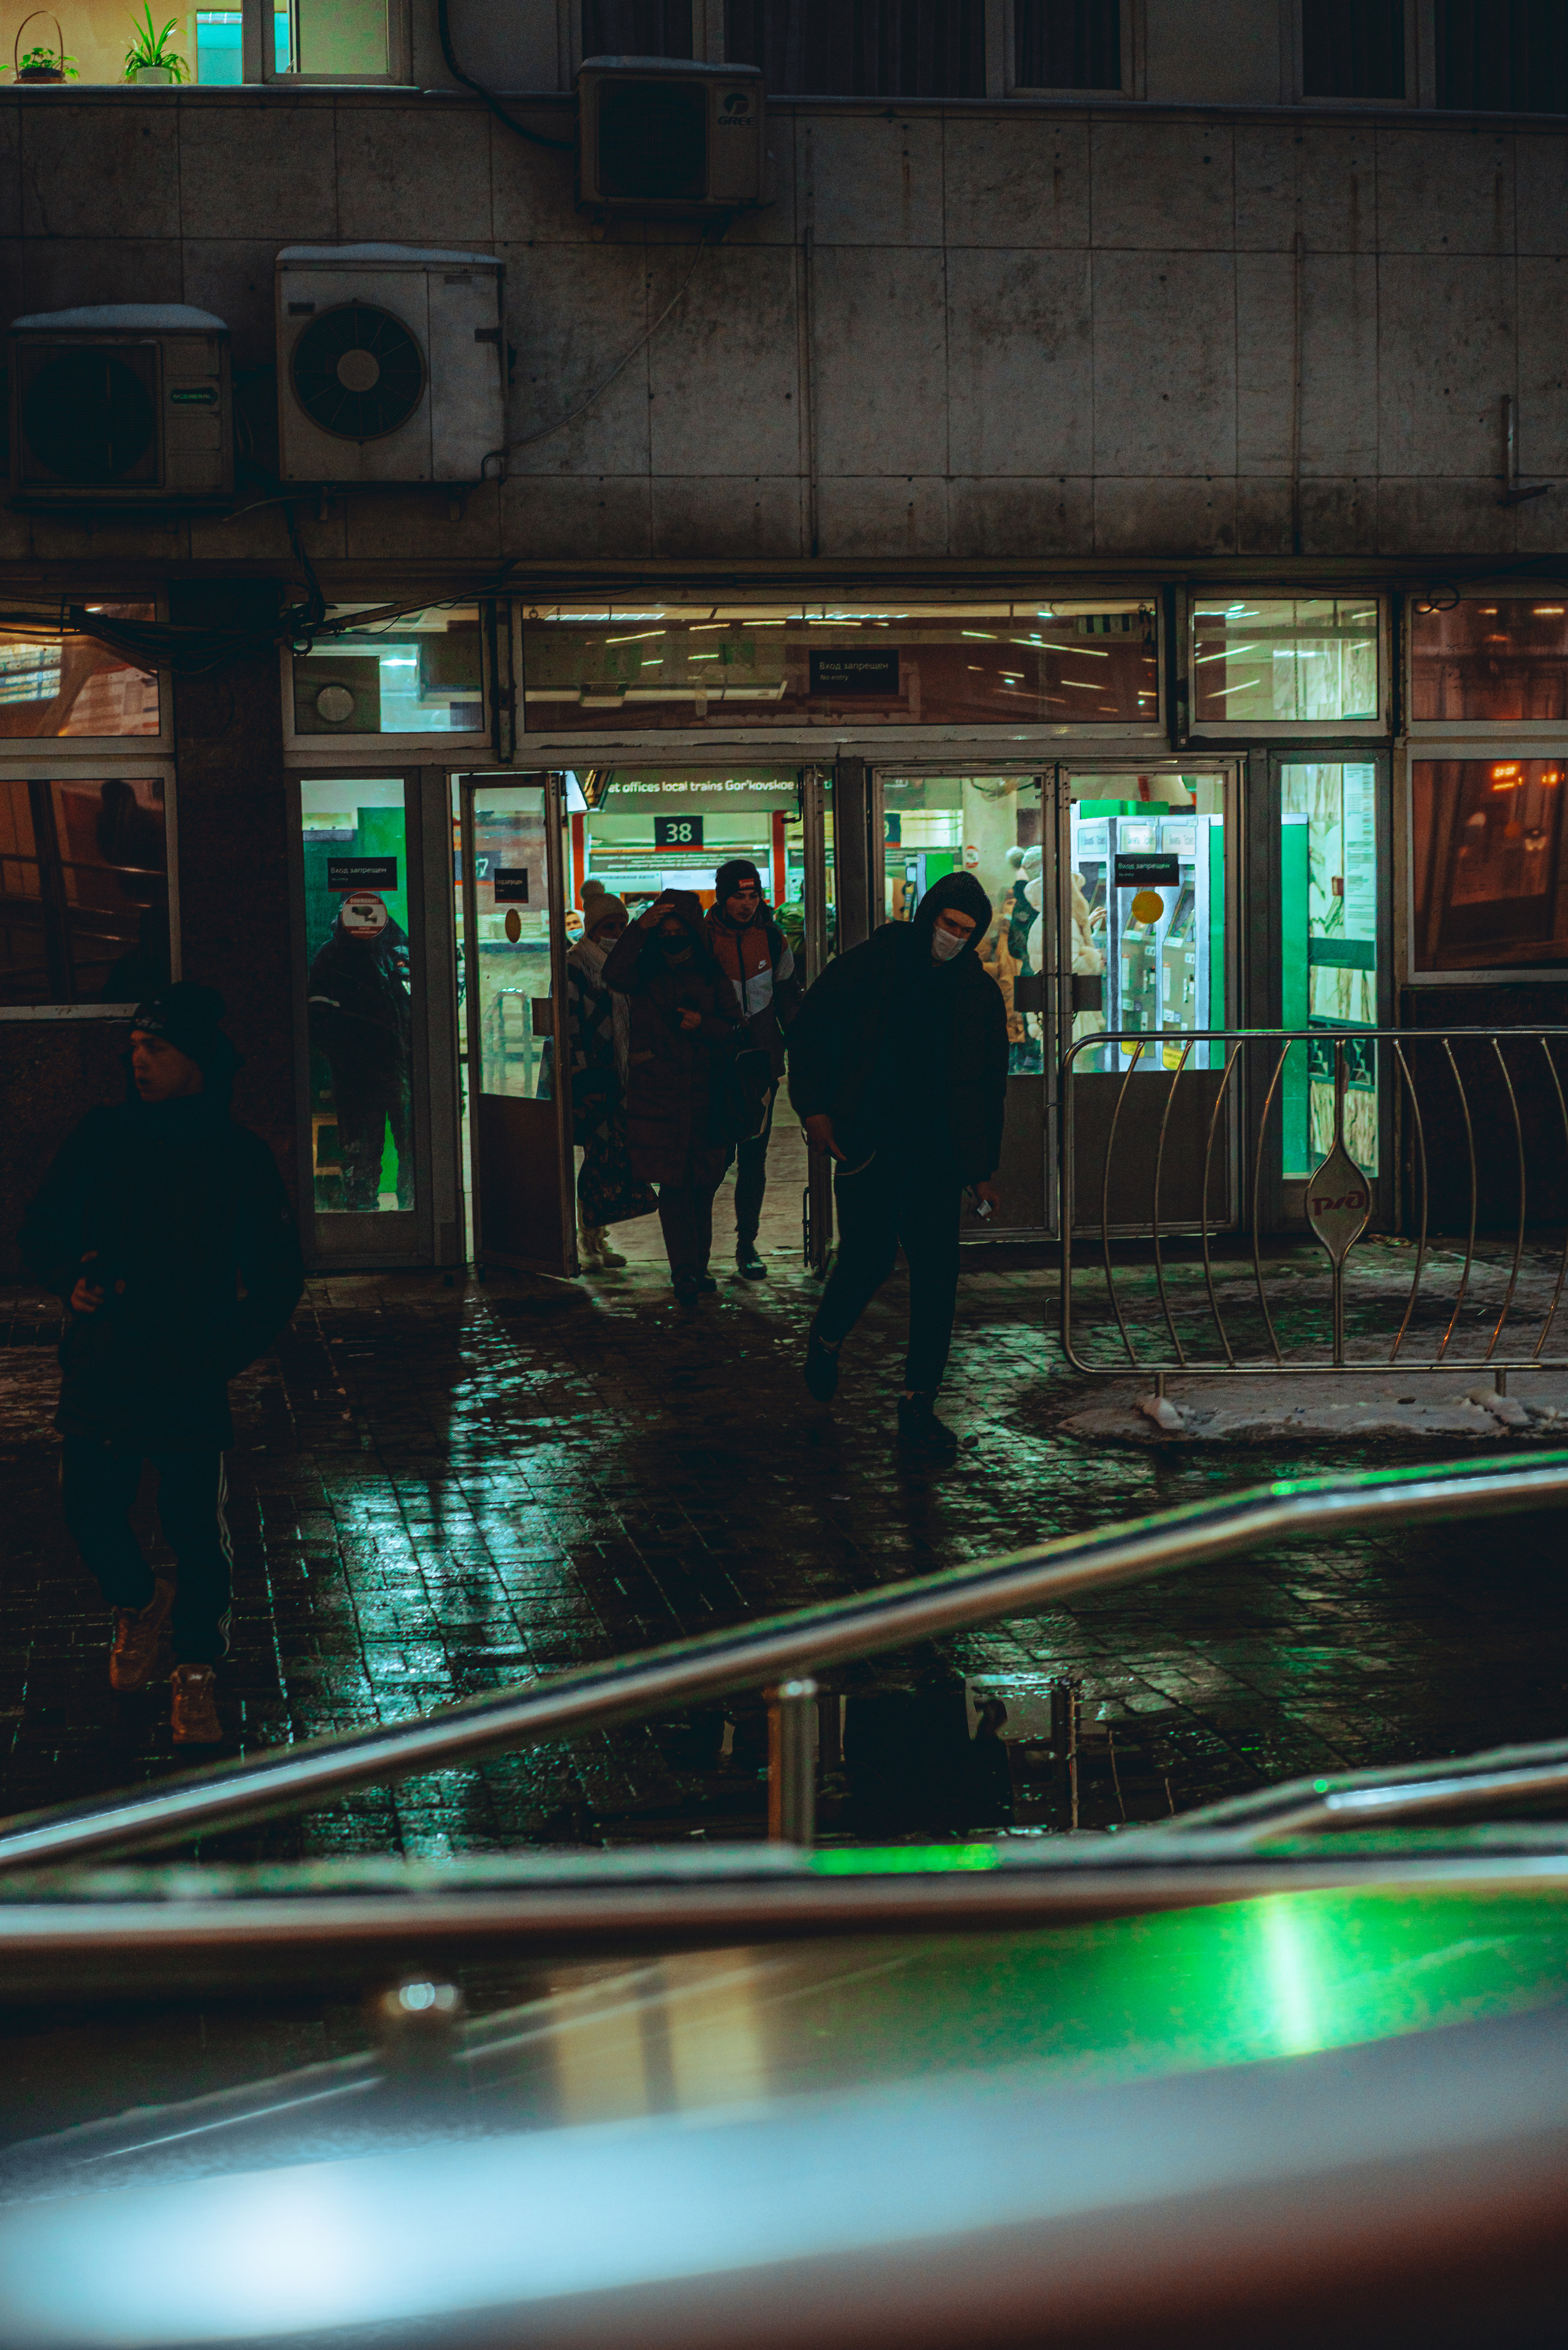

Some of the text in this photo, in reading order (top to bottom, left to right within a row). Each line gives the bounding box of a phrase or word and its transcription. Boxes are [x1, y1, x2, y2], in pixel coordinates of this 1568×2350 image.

[718, 116, 755, 126] GREE
[819, 661, 889, 672] Вход запрещен
[622, 781, 660, 793] offices
[662, 781, 688, 792] local
[690, 780, 723, 792] trains
[666, 823, 692, 842] 38
